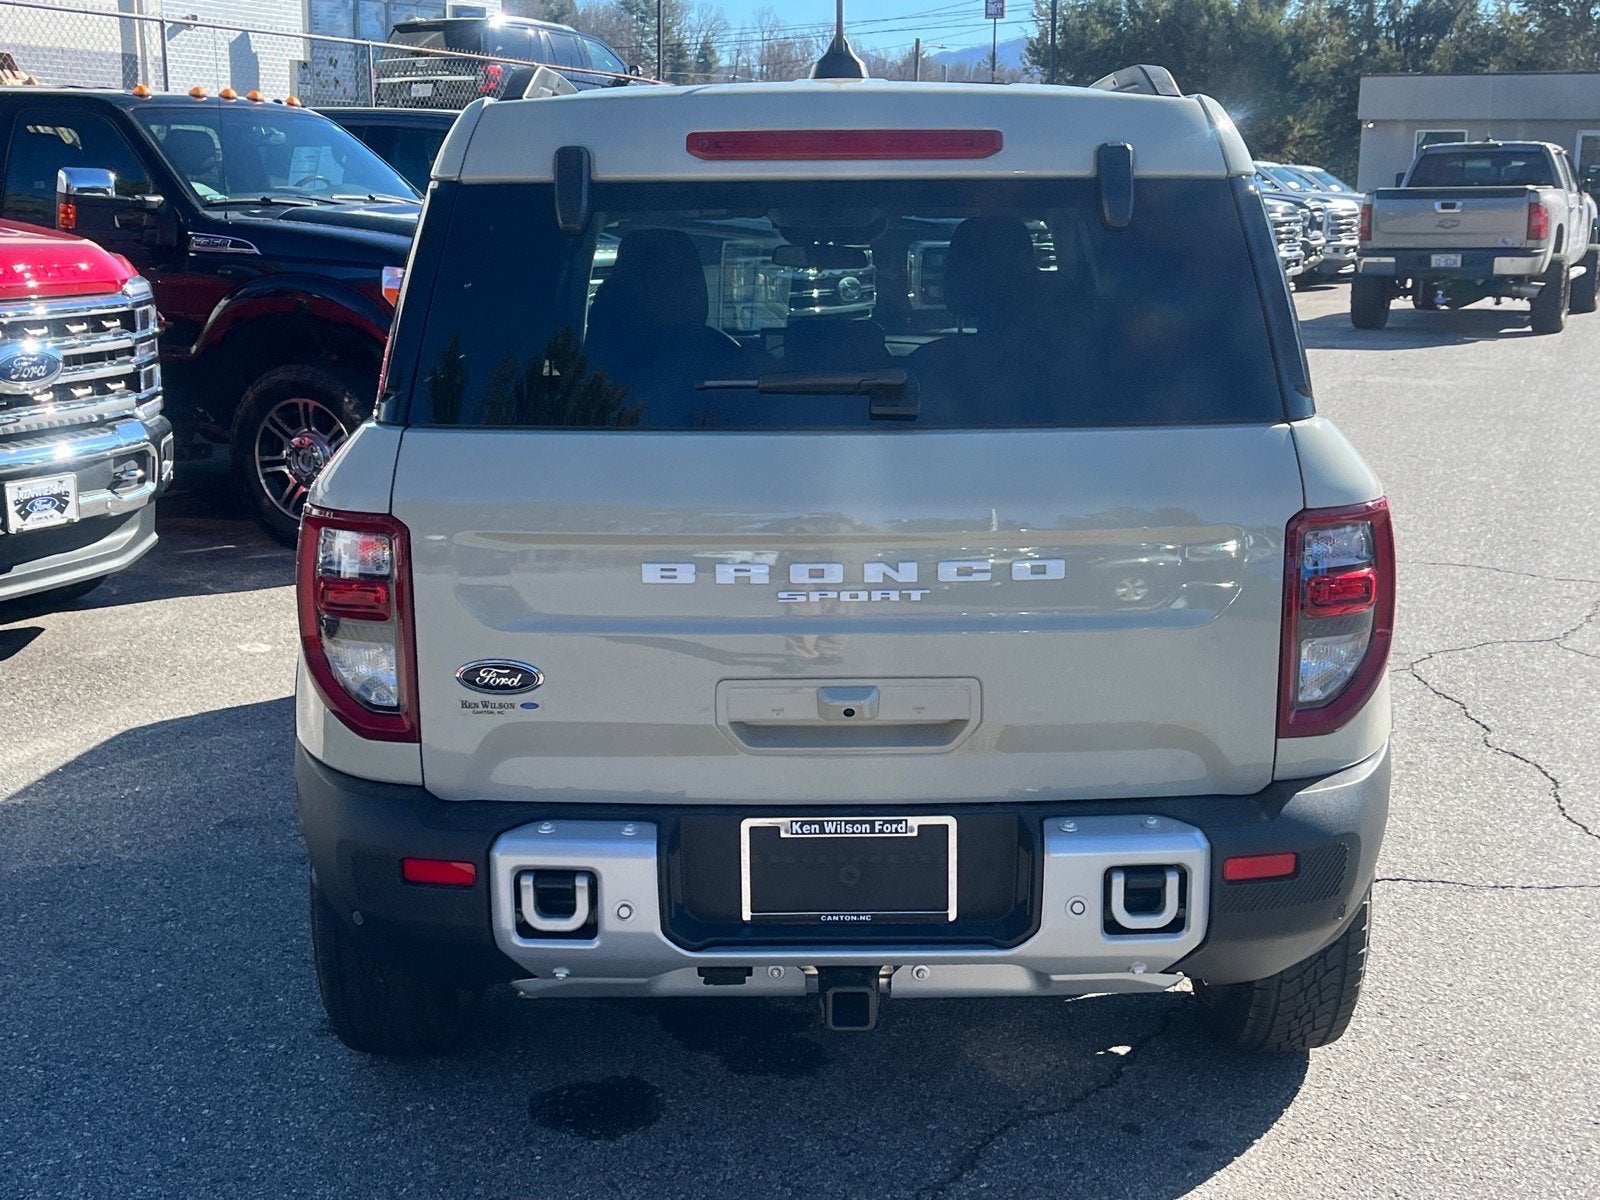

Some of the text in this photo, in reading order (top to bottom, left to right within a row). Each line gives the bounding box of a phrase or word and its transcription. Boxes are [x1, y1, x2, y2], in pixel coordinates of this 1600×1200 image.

[11, 357, 48, 379] Ford
[641, 559, 1066, 585] BRONCO
[777, 589, 930, 603] SPORT
[475, 667, 522, 687] Ford
[792, 821, 906, 834] Ken Wilson Ford
